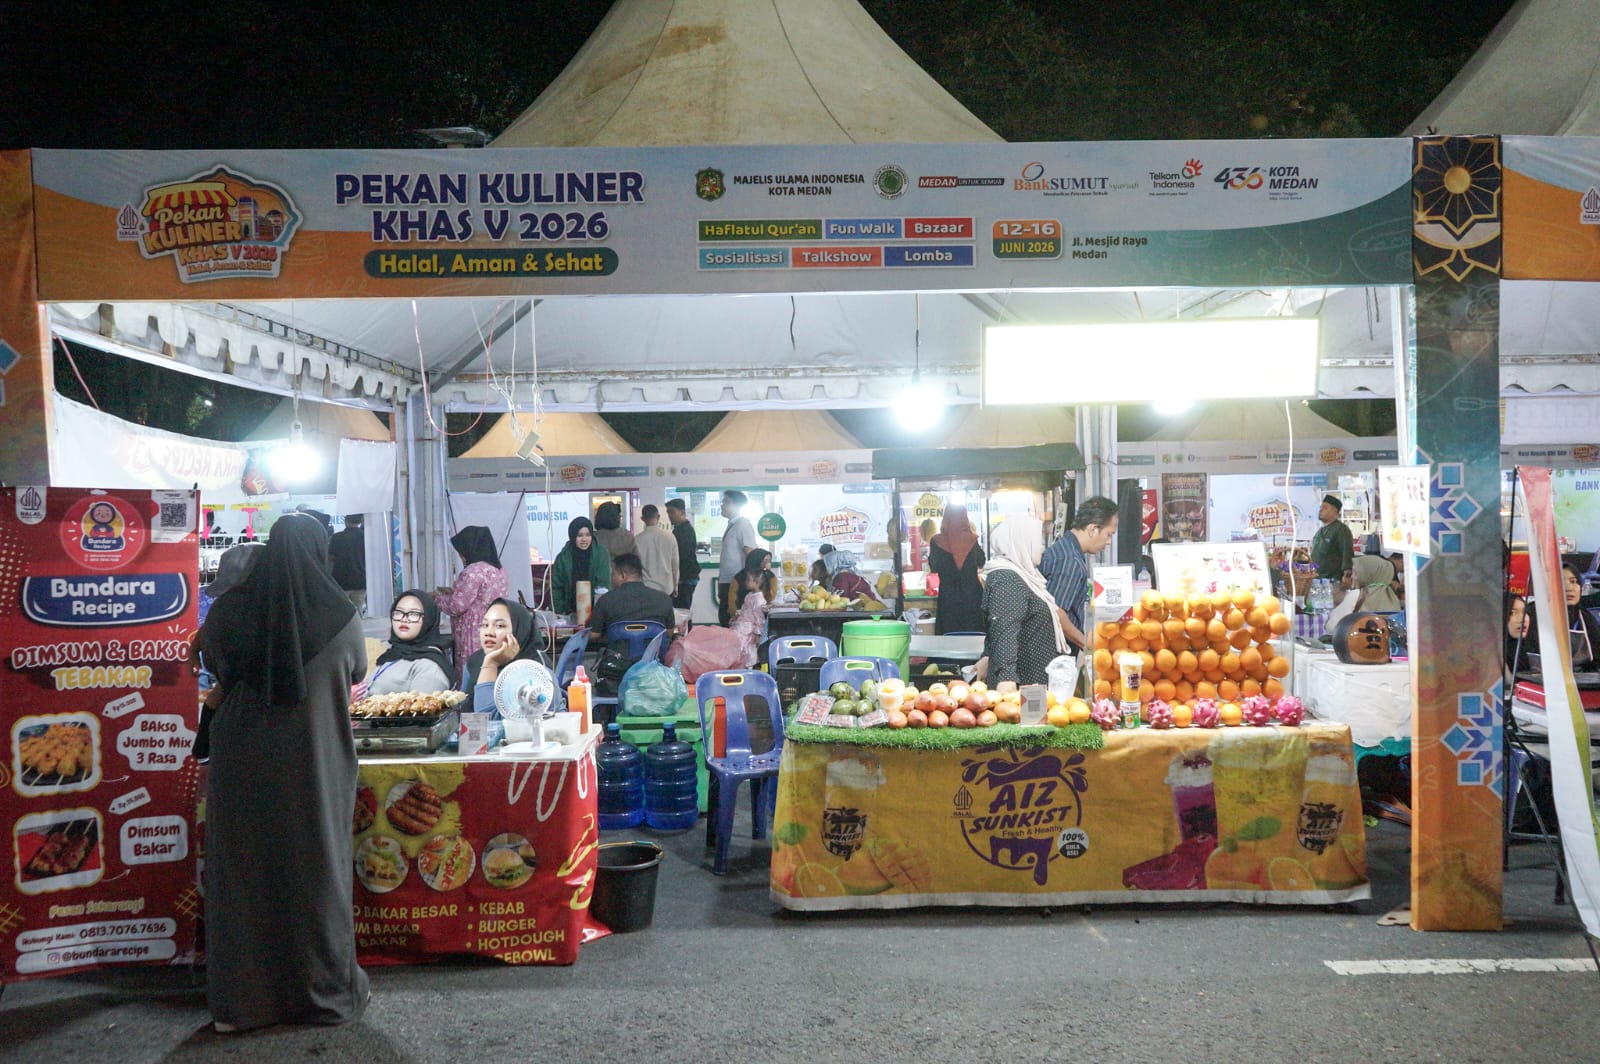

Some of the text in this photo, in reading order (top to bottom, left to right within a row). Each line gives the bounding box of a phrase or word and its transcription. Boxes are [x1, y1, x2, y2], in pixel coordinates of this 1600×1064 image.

[1149, 172, 1180, 181] Telkom
[1268, 167, 1300, 177] KOTA
[734, 174, 864, 185] MAJELIS ULAMA INDONESIA
[919, 177, 957, 187] MEDAN
[1153, 179, 1195, 189] Indonesia
[1268, 178, 1318, 190] MEDAN
[335, 172, 644, 204] PEKAN KULINER
[768, 185, 832, 196] KOTA MEDAN
[154, 206, 224, 231] Pekan
[371, 209, 609, 241] KHAS V 2026
[704, 223, 816, 237] Haflatul Qur'an
[830, 222, 895, 235] Fun Walk
[914, 222, 964, 234] Bazaar
[143, 221, 242, 252] KULINER
[1085, 236, 1121, 249] Mesjid
[1122, 237, 1148, 249] Raya
[999, 239, 1055, 254] JUNI 2026
[178, 246, 228, 266] KHAS
[705, 250, 784, 264] Sosialisasi
[802, 250, 872, 263] Talkshow
[904, 250, 953, 262] Lomba
[1072, 249, 1108, 260] Medan
[379, 252, 604, 276] Halal, Aman & Sehat
[1575, 481, 1600, 491] BANK
[915, 508, 944, 517] OPEN
[51, 577, 156, 598] Bundara
[71, 599, 136, 618] Recipe
[12, 640, 191, 669] DIMSUM & BAKSO
[52, 666, 152, 690] TEBAKAR
[123, 736, 191, 749] Jumbo Mix
[136, 752, 177, 764] 3 Rasa
[989, 780, 1058, 814] AIZ
[969, 806, 1073, 834] SUNKIST
[127, 825, 180, 839] Dimsum
[1002, 828, 1025, 837] Fresh
[1034, 826, 1063, 834] Healthy
[1062, 832, 1085, 841] 100%
[134, 842, 176, 856] Bakar
[364, 906, 408, 919] BAKAR
[411, 904, 458, 919] BESAR
[479, 902, 525, 915] KEBAB
[373, 923, 420, 935] BAKAR
[479, 918, 536, 933] BURGER
[478, 929, 565, 951] HOTDOUGH
